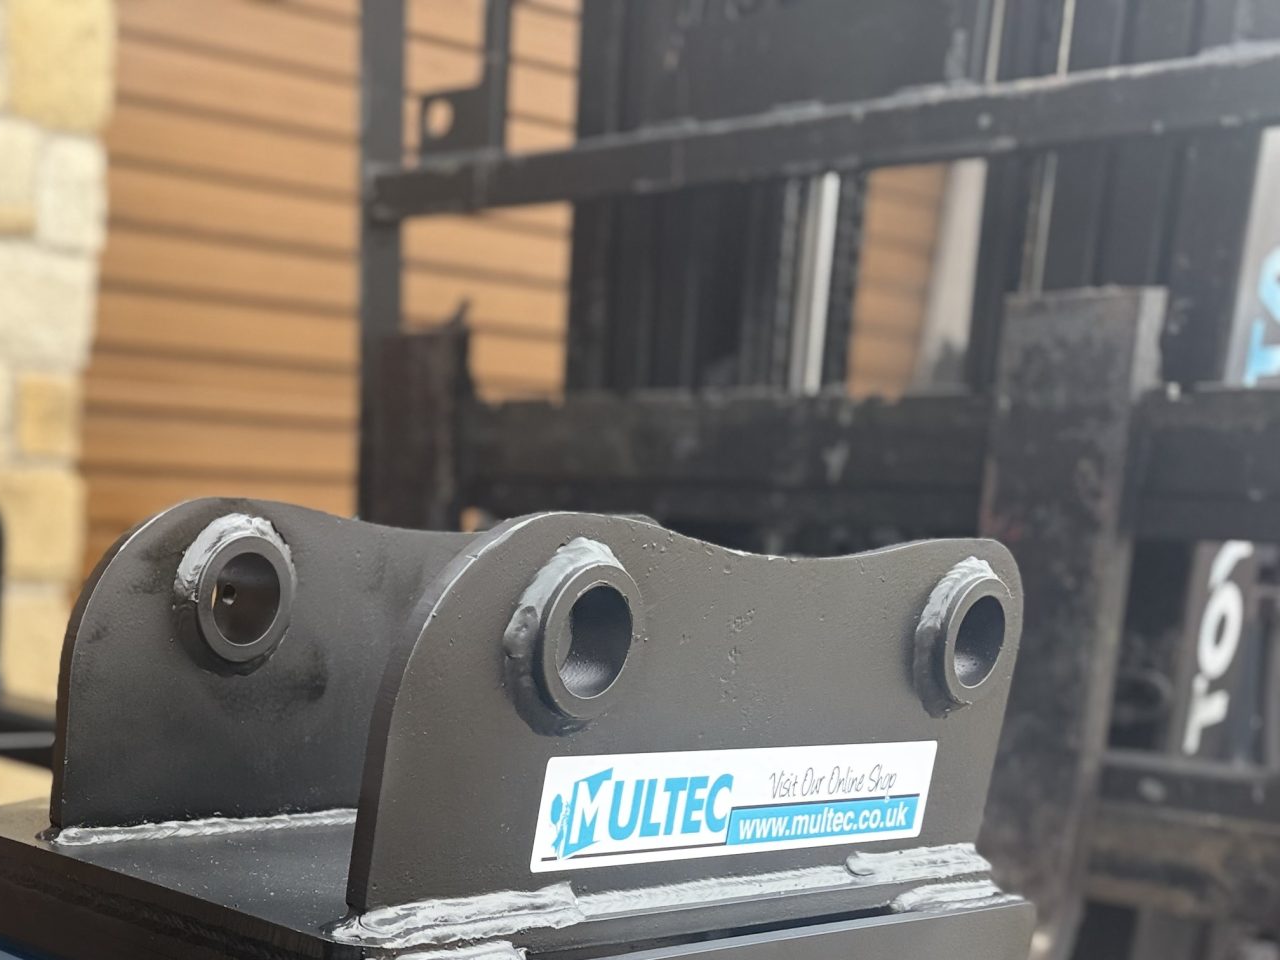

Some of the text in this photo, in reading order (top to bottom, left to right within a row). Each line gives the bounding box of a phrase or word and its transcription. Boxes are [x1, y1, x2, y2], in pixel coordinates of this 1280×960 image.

[768, 763, 898, 803] Visit Our Online Shop
[565, 769, 734, 853] MULTEC
[738, 801, 910, 841] www.multec.co.uk
